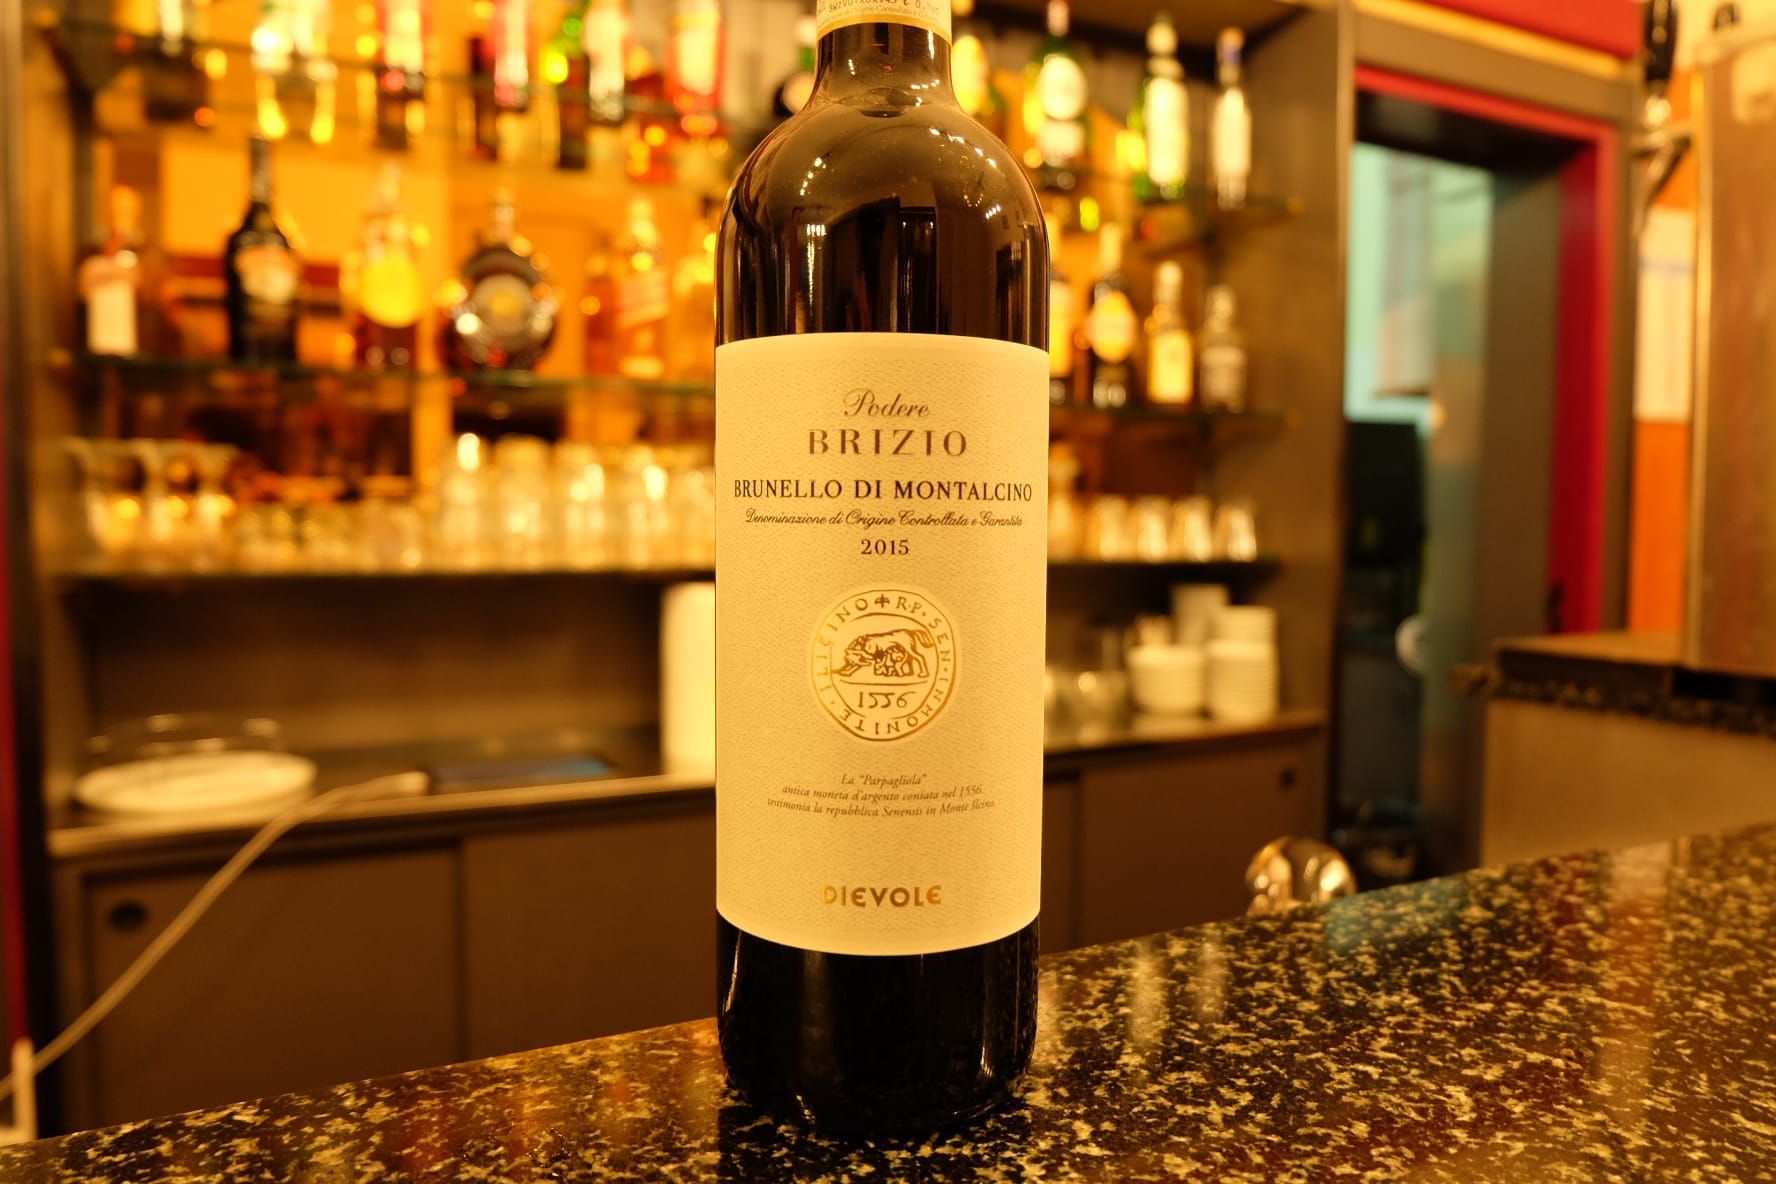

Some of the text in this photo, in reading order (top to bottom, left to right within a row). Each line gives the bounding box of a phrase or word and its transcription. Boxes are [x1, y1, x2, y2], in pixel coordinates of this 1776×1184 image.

[843, 388, 930, 418] Podere
[809, 429, 967, 456] BRIZIO
[734, 479, 1033, 502] BRUNELLO DI MONTALCINO
[745, 508, 826, 525] Denominazione
[828, 510, 844, 525] di
[845, 508, 895, 530] Origine
[898, 510, 968, 527] Controllata
[861, 539, 909, 555] 2015
[857, 691, 916, 709] 1556
[841, 773, 854, 785] La
[782, 786, 810, 797] antica
[813, 790, 849, 800] moneta
[852, 789, 899, 804] d'argento
[902, 790, 939, 801] coniata
[942, 787, 956, 799] nel
[767, 798, 811, 813] testimonia
[813, 803, 823, 814] la
[826, 804, 879, 818] repubblica
[881, 805, 923, 817] Senensis
[925, 805, 937, 816] in
[939, 802, 969, 815] Monte
[823, 884, 942, 908] DIEVOLE
